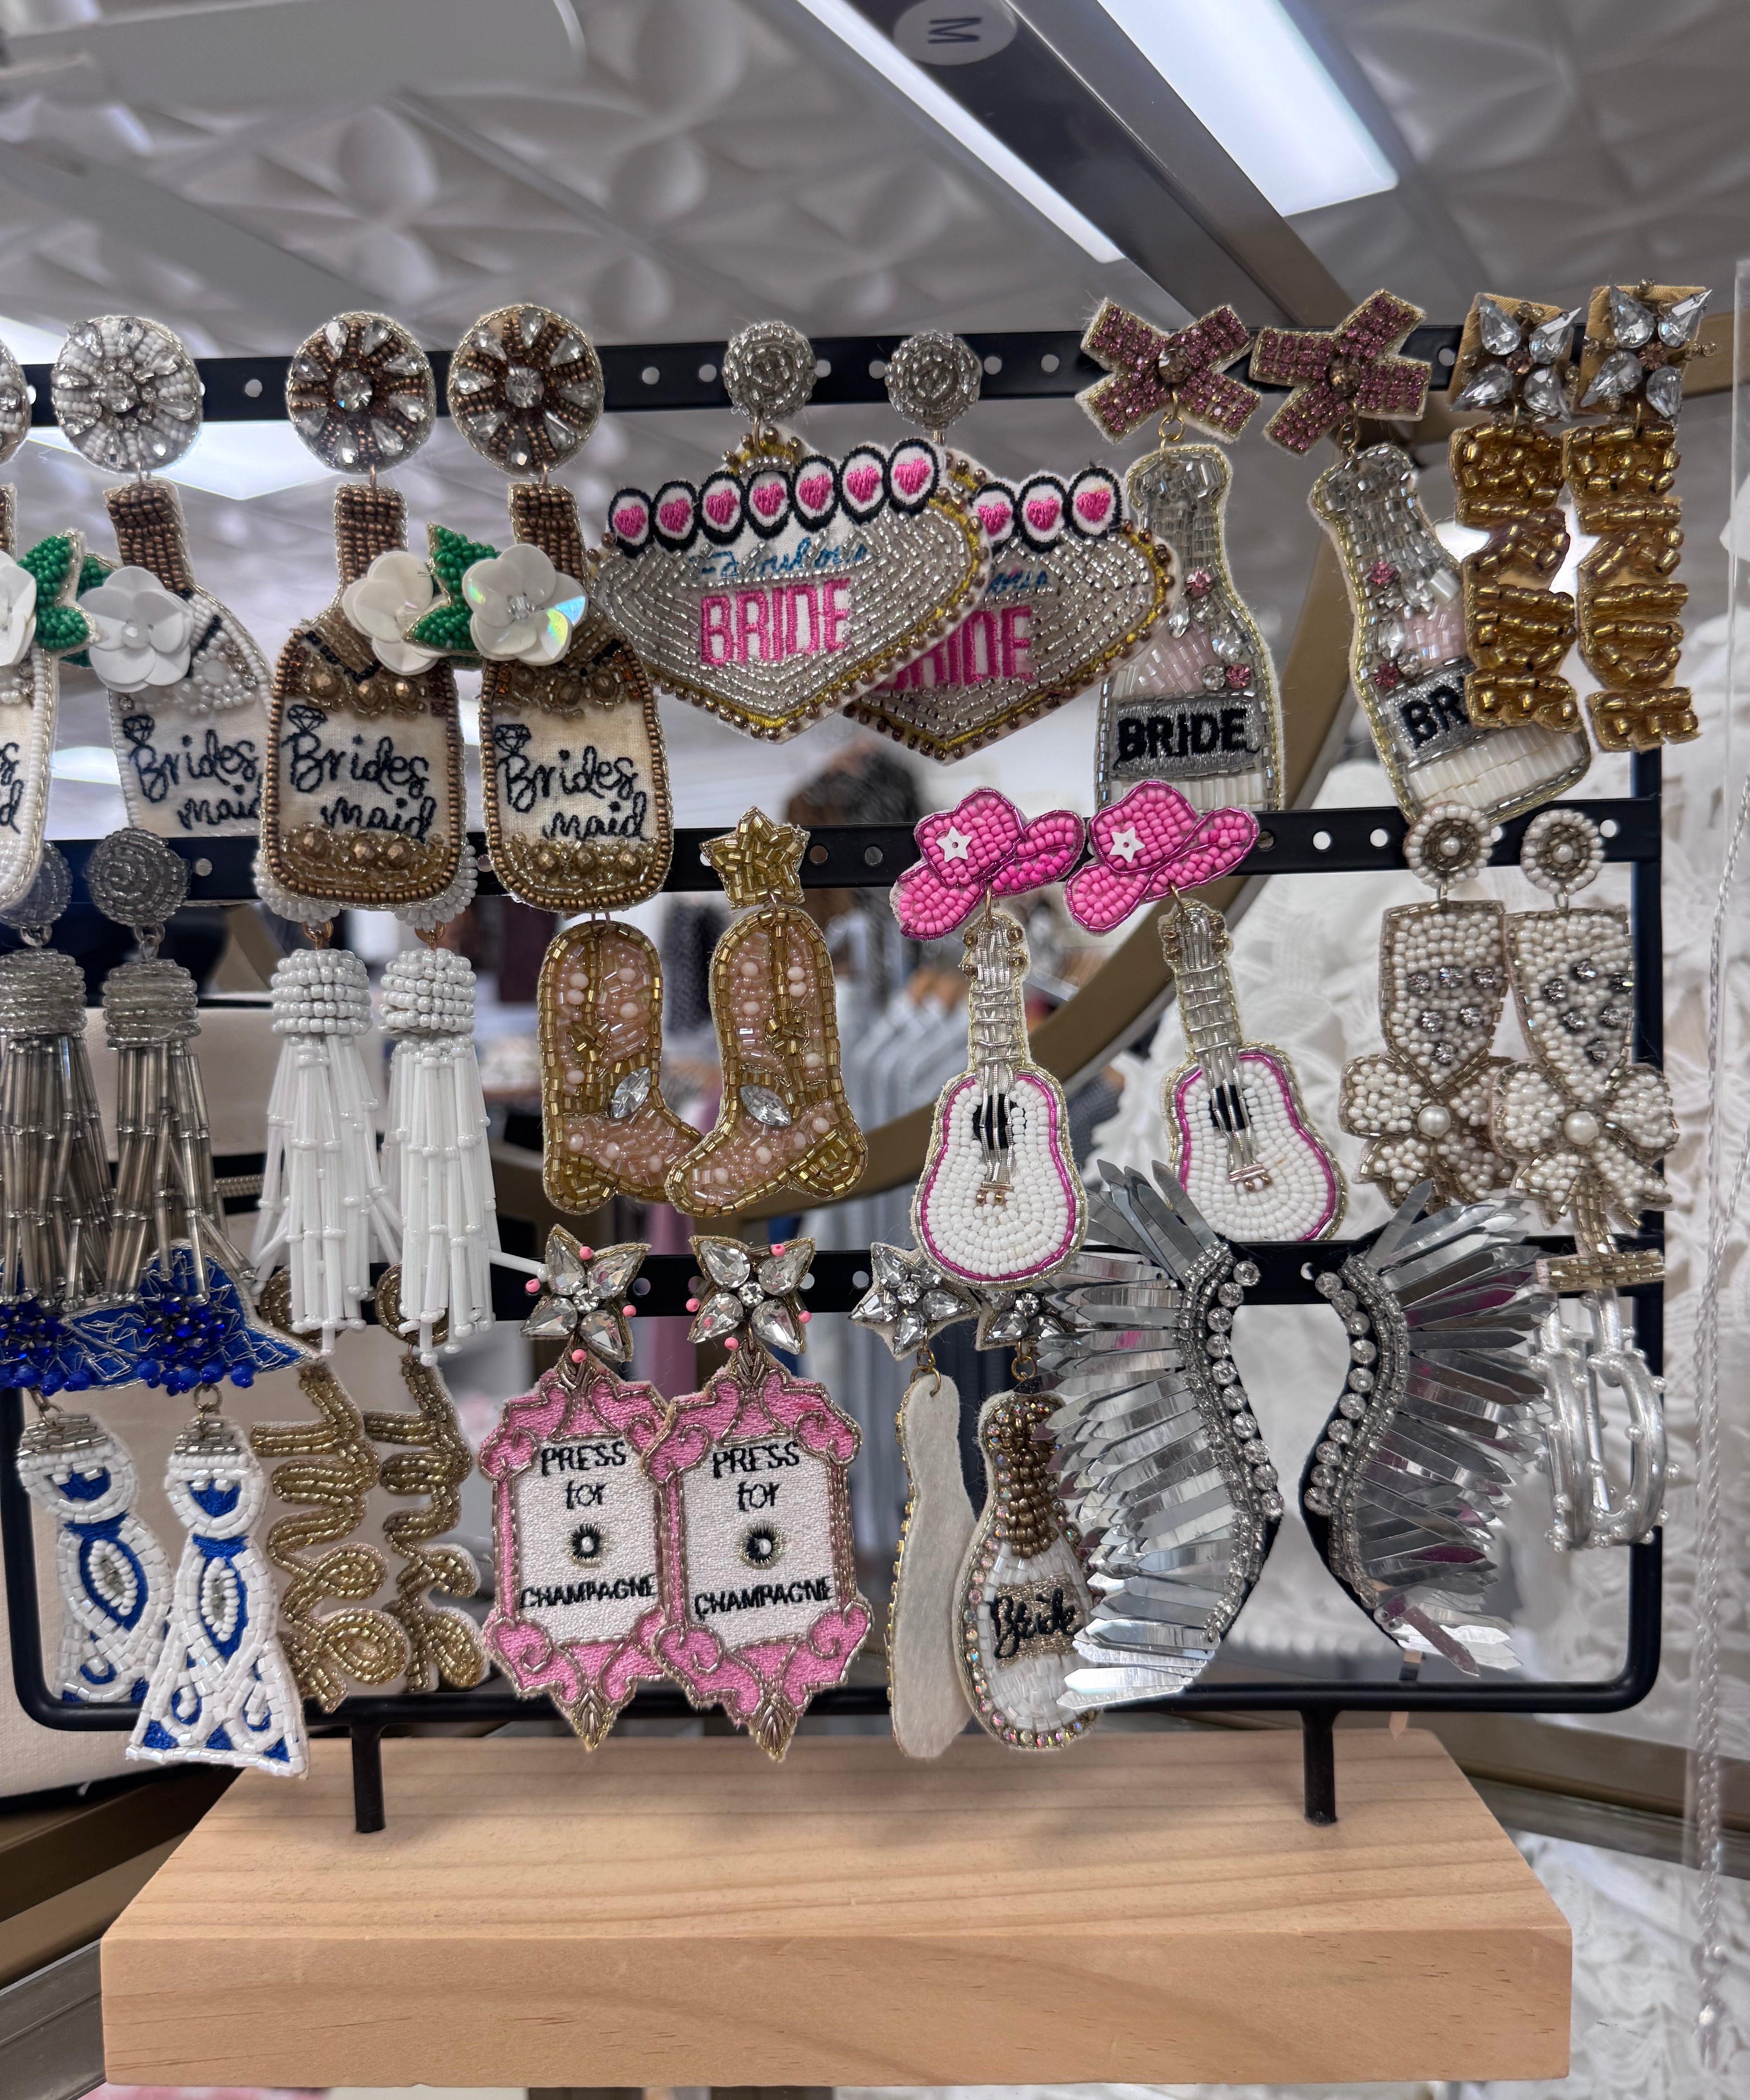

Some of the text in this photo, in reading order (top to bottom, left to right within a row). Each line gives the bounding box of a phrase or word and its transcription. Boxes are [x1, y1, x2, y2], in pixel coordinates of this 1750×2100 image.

[701, 578, 850, 668] BRIDE
[1117, 708, 1248, 764] BRIDE
[128, 728, 259, 803] Brides
[282, 733, 429, 800] Brides
[496, 746, 638, 813] Brides
[321, 795, 437, 843] maid
[542, 791, 648, 842] maid
[540, 1441, 627, 1477] PRESS
[712, 1441, 800, 1479] PRESS
[519, 1573, 657, 1609] CHAMPAGNE
[694, 1576, 833, 1621] CHAMPAGNE
